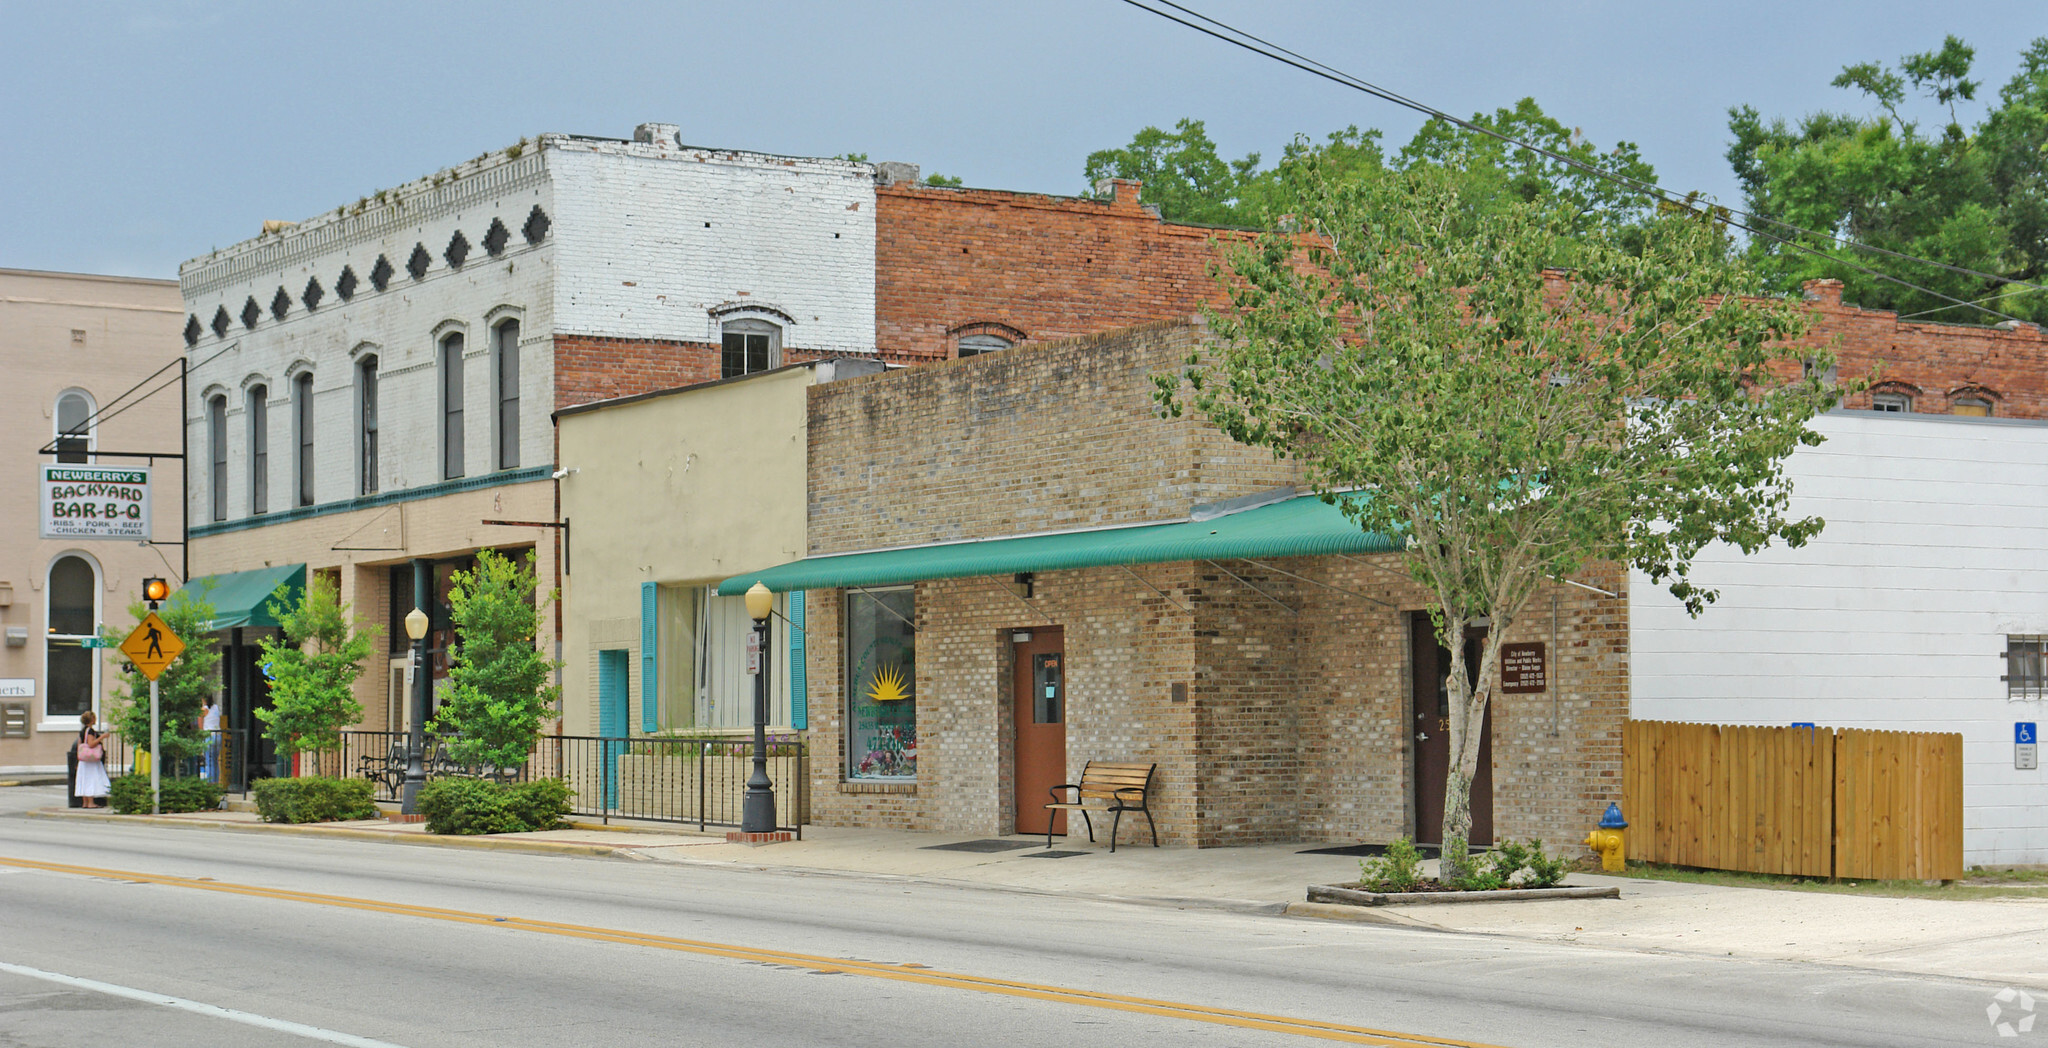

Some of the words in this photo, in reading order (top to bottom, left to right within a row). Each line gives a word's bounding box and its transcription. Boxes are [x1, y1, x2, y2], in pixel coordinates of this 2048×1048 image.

[51, 470, 142, 482] NEWBERRY'S
[52, 484, 143, 501] BACKYARD
[53, 502, 141, 520] BAR-B-Q
[85, 520, 110, 528] PORK
[122, 521, 144, 529] BEEF
[1044, 659, 1058, 668] OPEN
